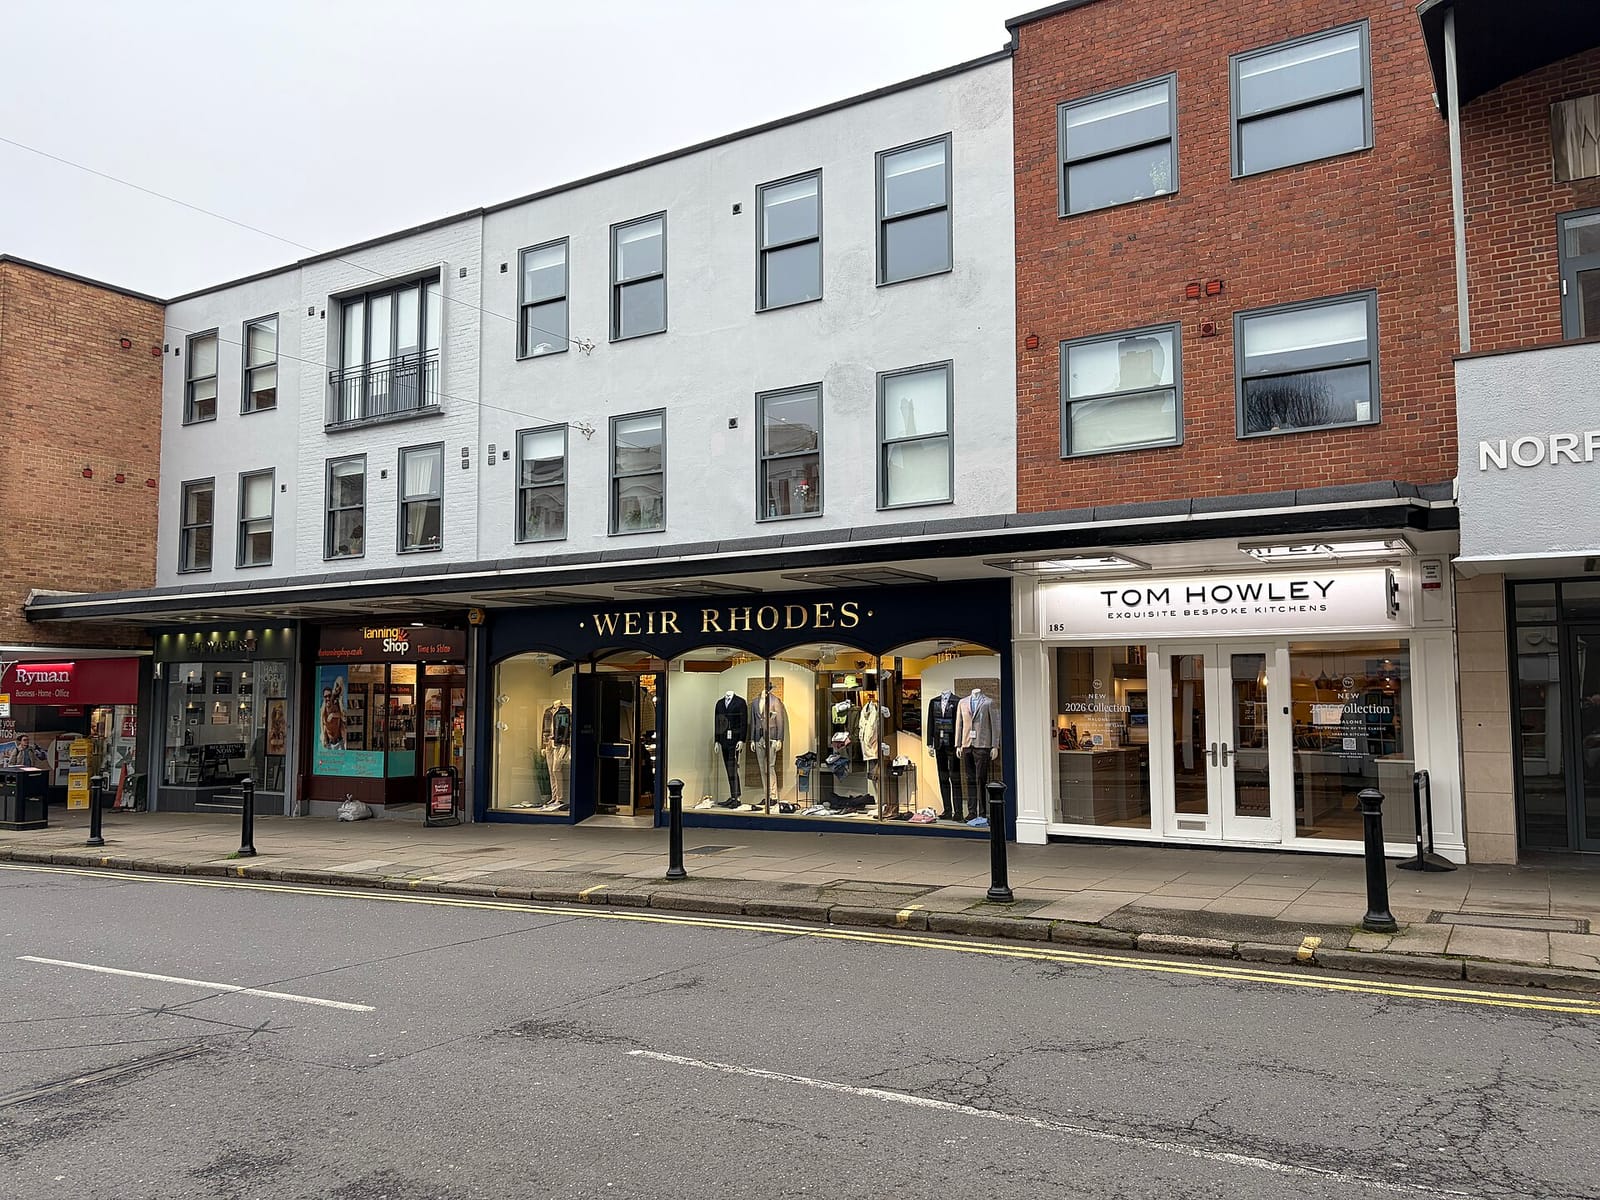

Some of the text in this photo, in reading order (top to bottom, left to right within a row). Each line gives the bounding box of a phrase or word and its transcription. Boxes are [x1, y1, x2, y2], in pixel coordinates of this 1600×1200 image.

[1479, 431, 1600, 471] NORF
[1100, 580, 1335, 607] TOM HOWLEY
[1107, 604, 1328, 619] EXQUISITE BESPOKE KITCHENS
[592, 601, 860, 637] WEIR RHODES
[362, 627, 399, 641] Tanning
[1048, 623, 1065, 632] 185
[382, 638, 409, 655] Shop
[417, 643, 451, 653] Time to Shine
[15, 669, 70, 685] Ryman
[15, 689, 70, 697] Business Home Office
[1065, 703, 1131, 713] 2026 Collection
[1337, 702, 1390, 714] ollection
[0, 729, 13, 739] TOS
